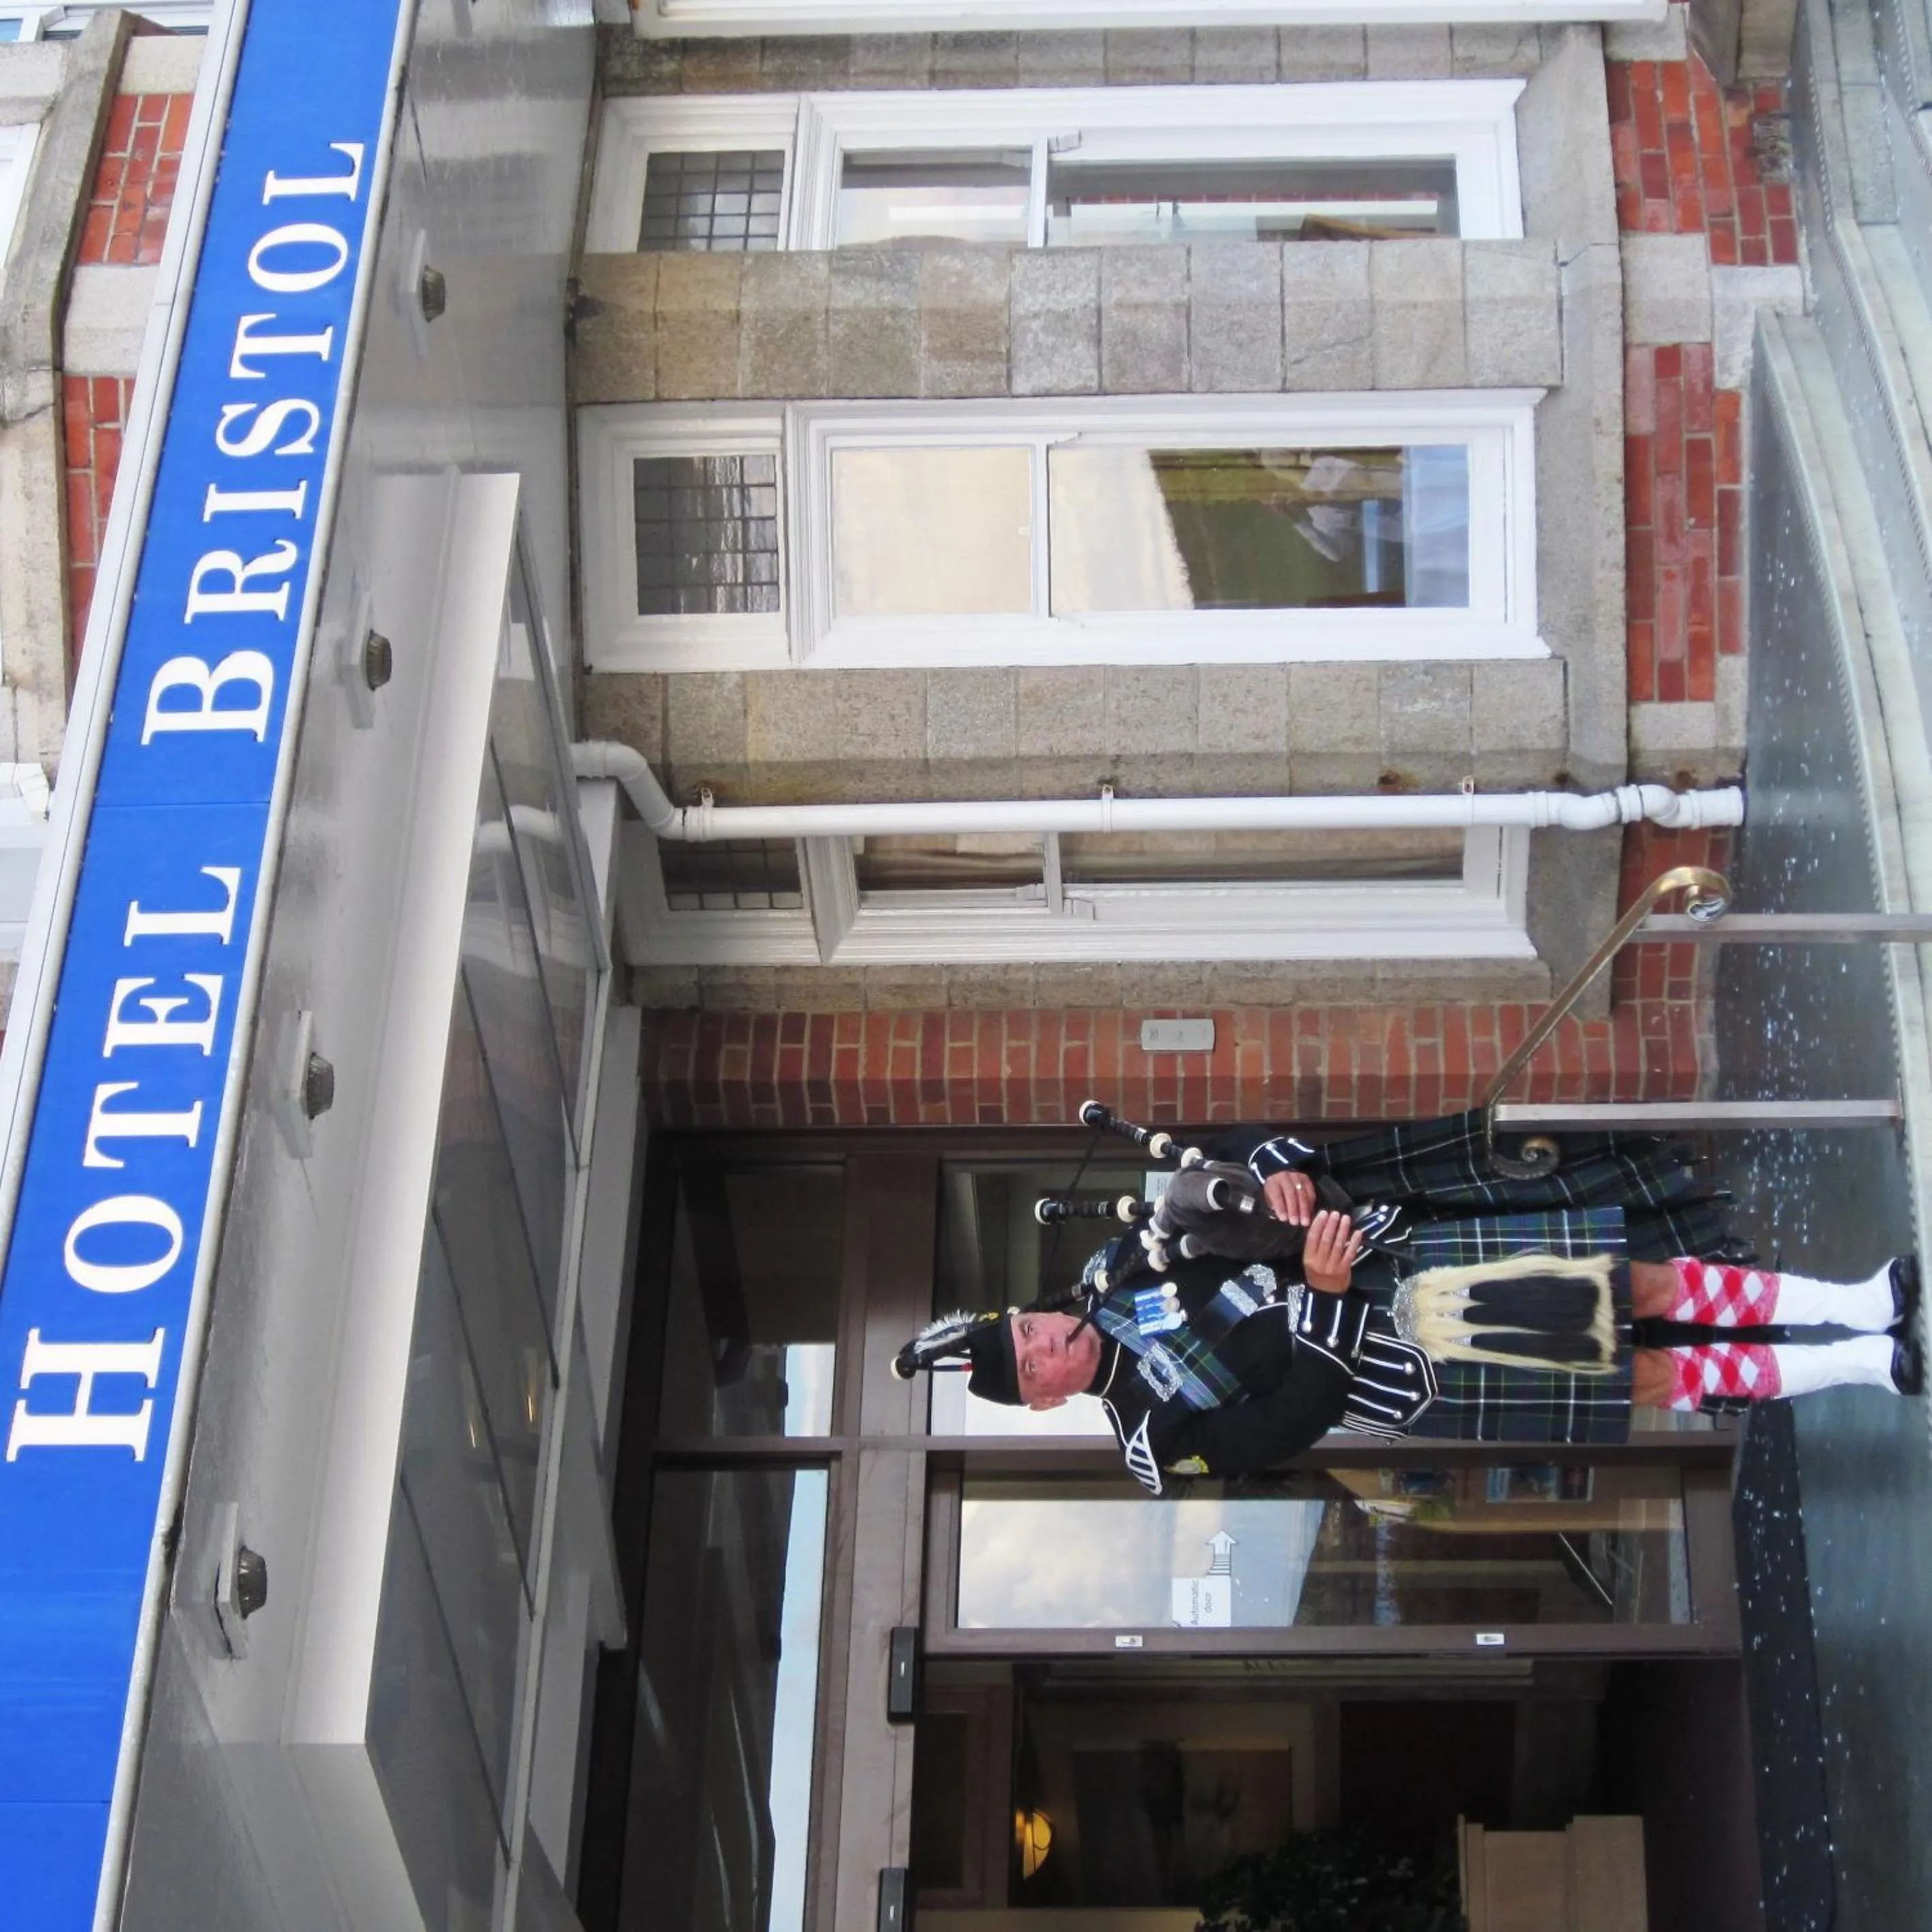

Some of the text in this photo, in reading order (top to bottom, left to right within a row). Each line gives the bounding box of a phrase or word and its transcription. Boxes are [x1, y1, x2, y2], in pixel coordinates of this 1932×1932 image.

[5, 142, 365, 1463] HOTEL BRISTOL
[1190, 1579, 1200, 1626] Automatic
[1203, 1591, 1212, 1614] door
